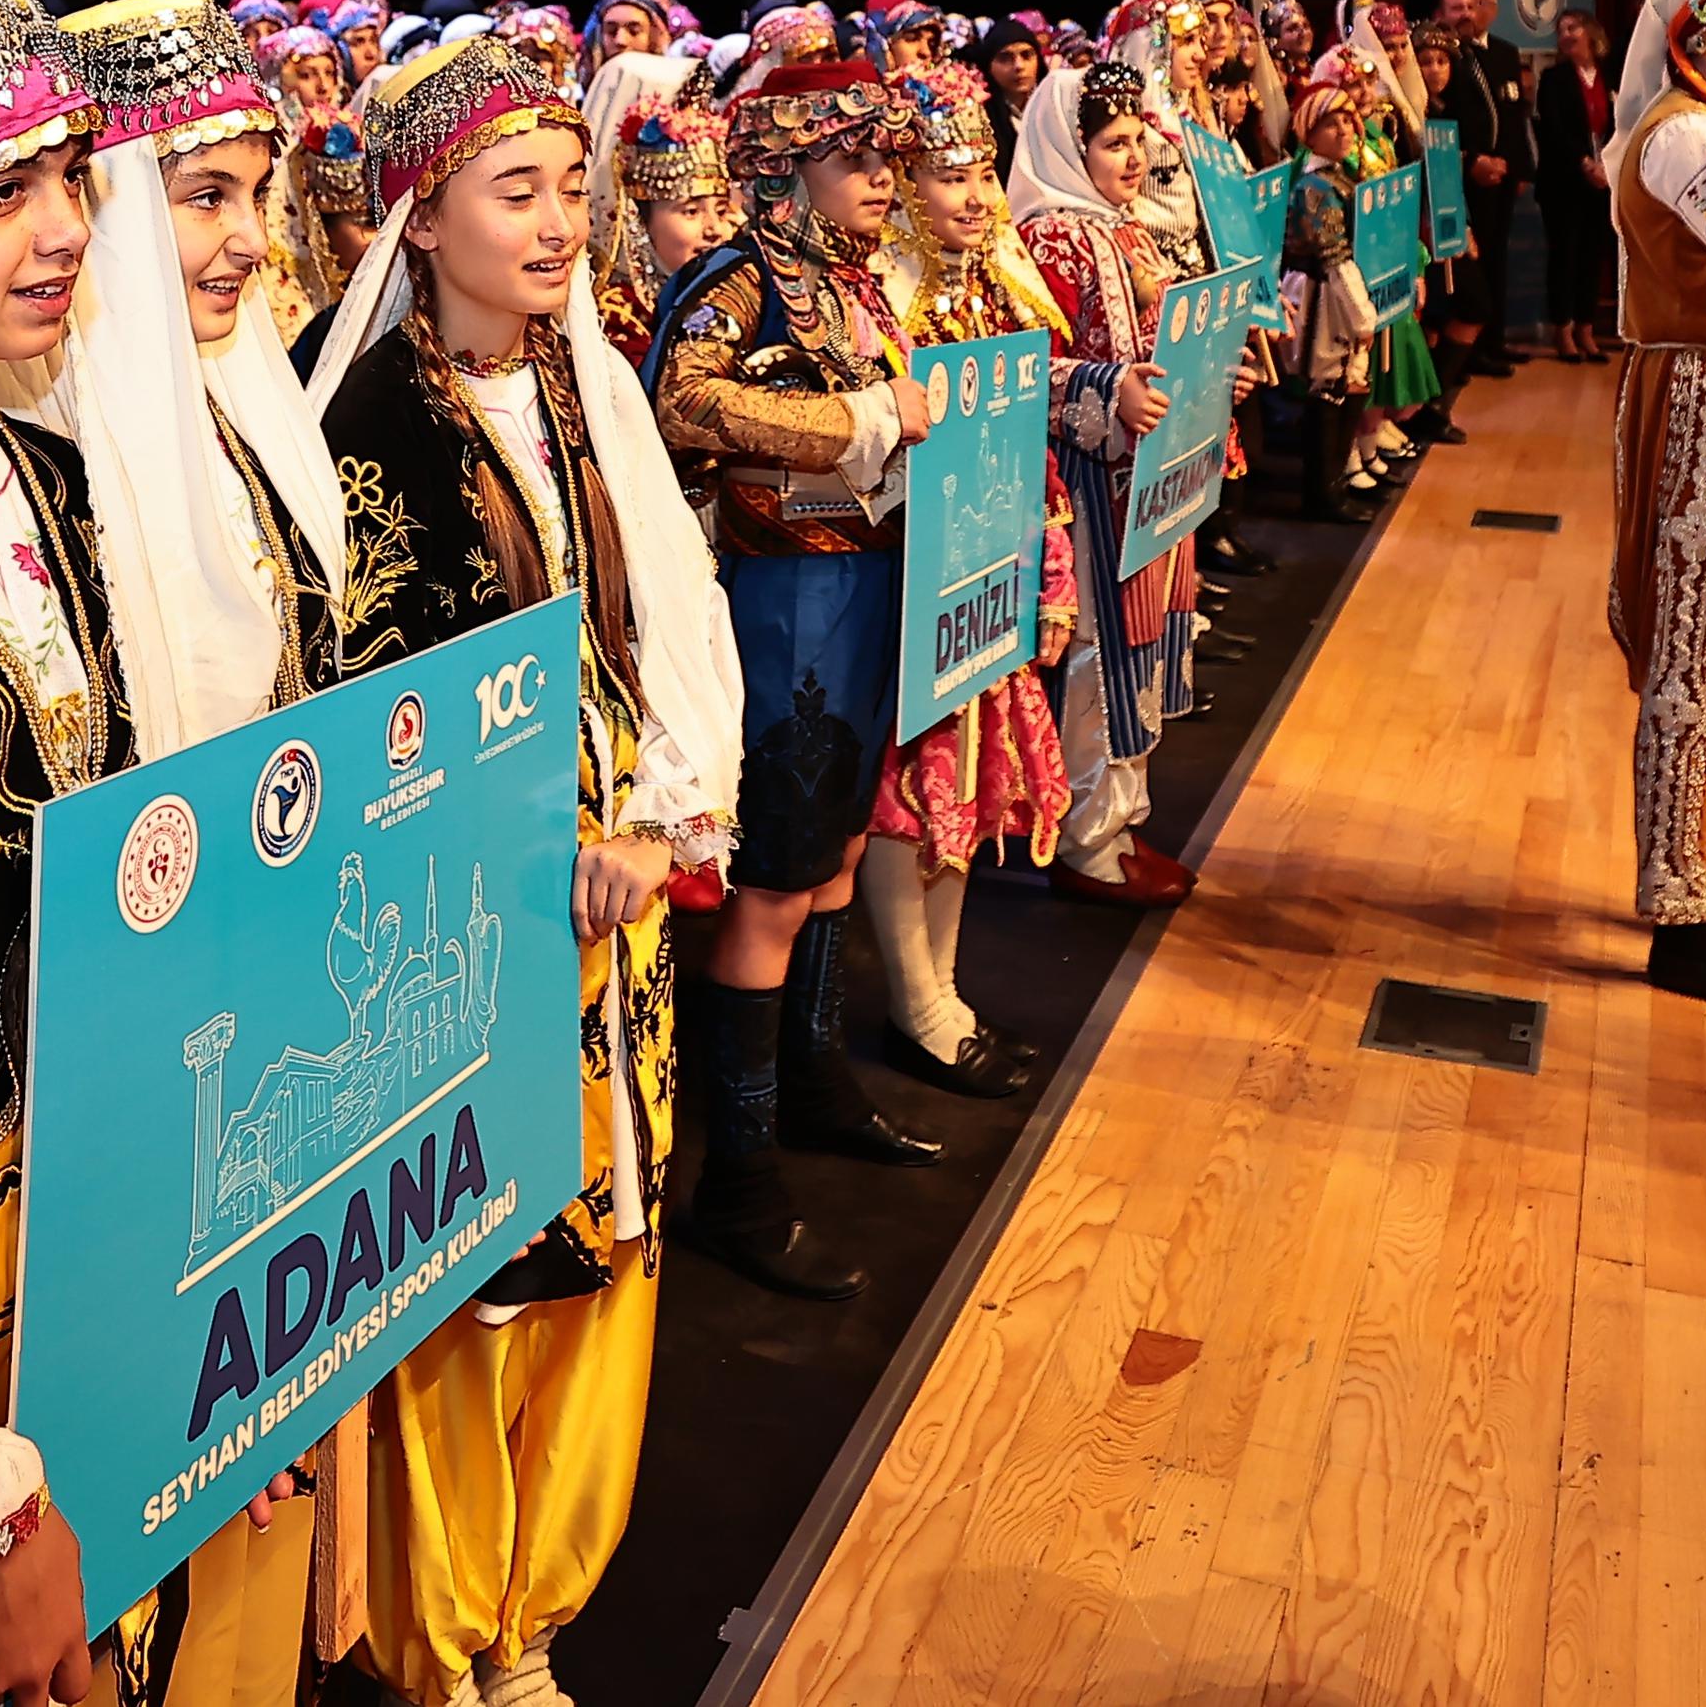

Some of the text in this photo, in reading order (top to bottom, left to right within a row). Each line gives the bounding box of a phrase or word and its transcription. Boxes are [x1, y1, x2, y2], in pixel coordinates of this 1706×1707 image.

[936, 560, 1019, 674] DENİZLİ
[141, 1177, 518, 1536] SEYHAN BELEDİYESİ SPOR KULÜBÜ
[187, 1103, 488, 1443] ADANA
